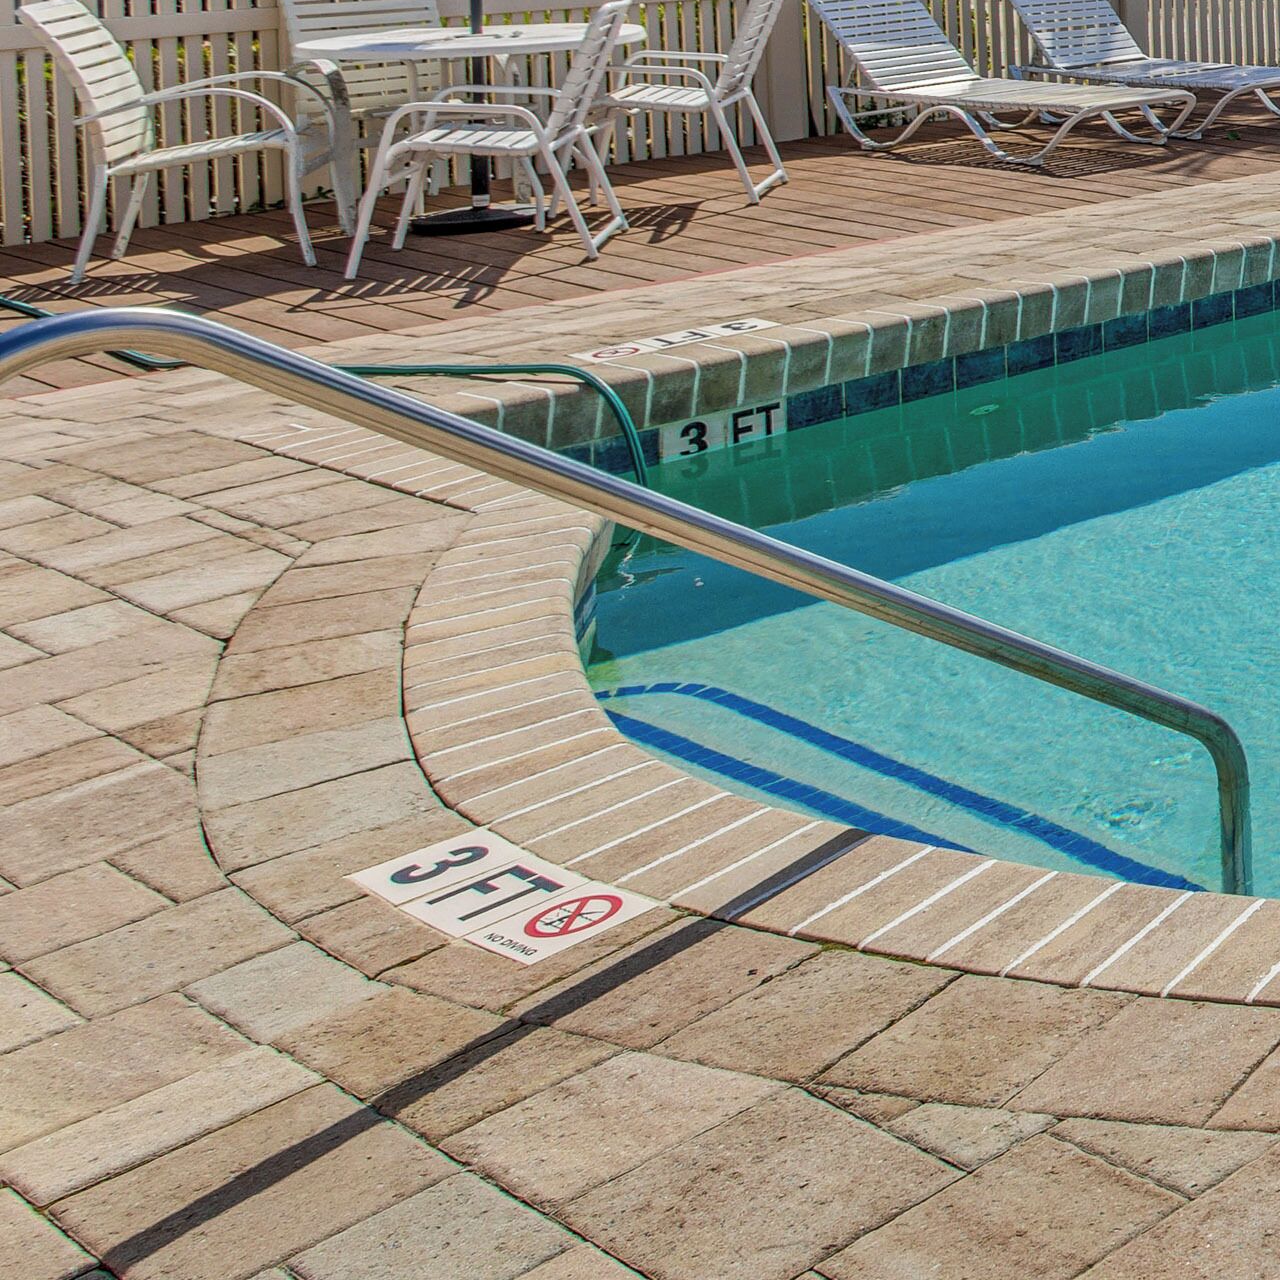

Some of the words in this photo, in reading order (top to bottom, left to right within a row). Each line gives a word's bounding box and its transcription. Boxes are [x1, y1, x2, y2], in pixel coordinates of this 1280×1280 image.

[652, 331, 713, 347] FT
[679, 420, 709, 457] 3
[731, 401, 781, 445] FT
[389, 845, 490, 885] 3
[425, 864, 566, 922] FT
[483, 932, 505, 942] NO
[499, 938, 539, 957] DIVING
